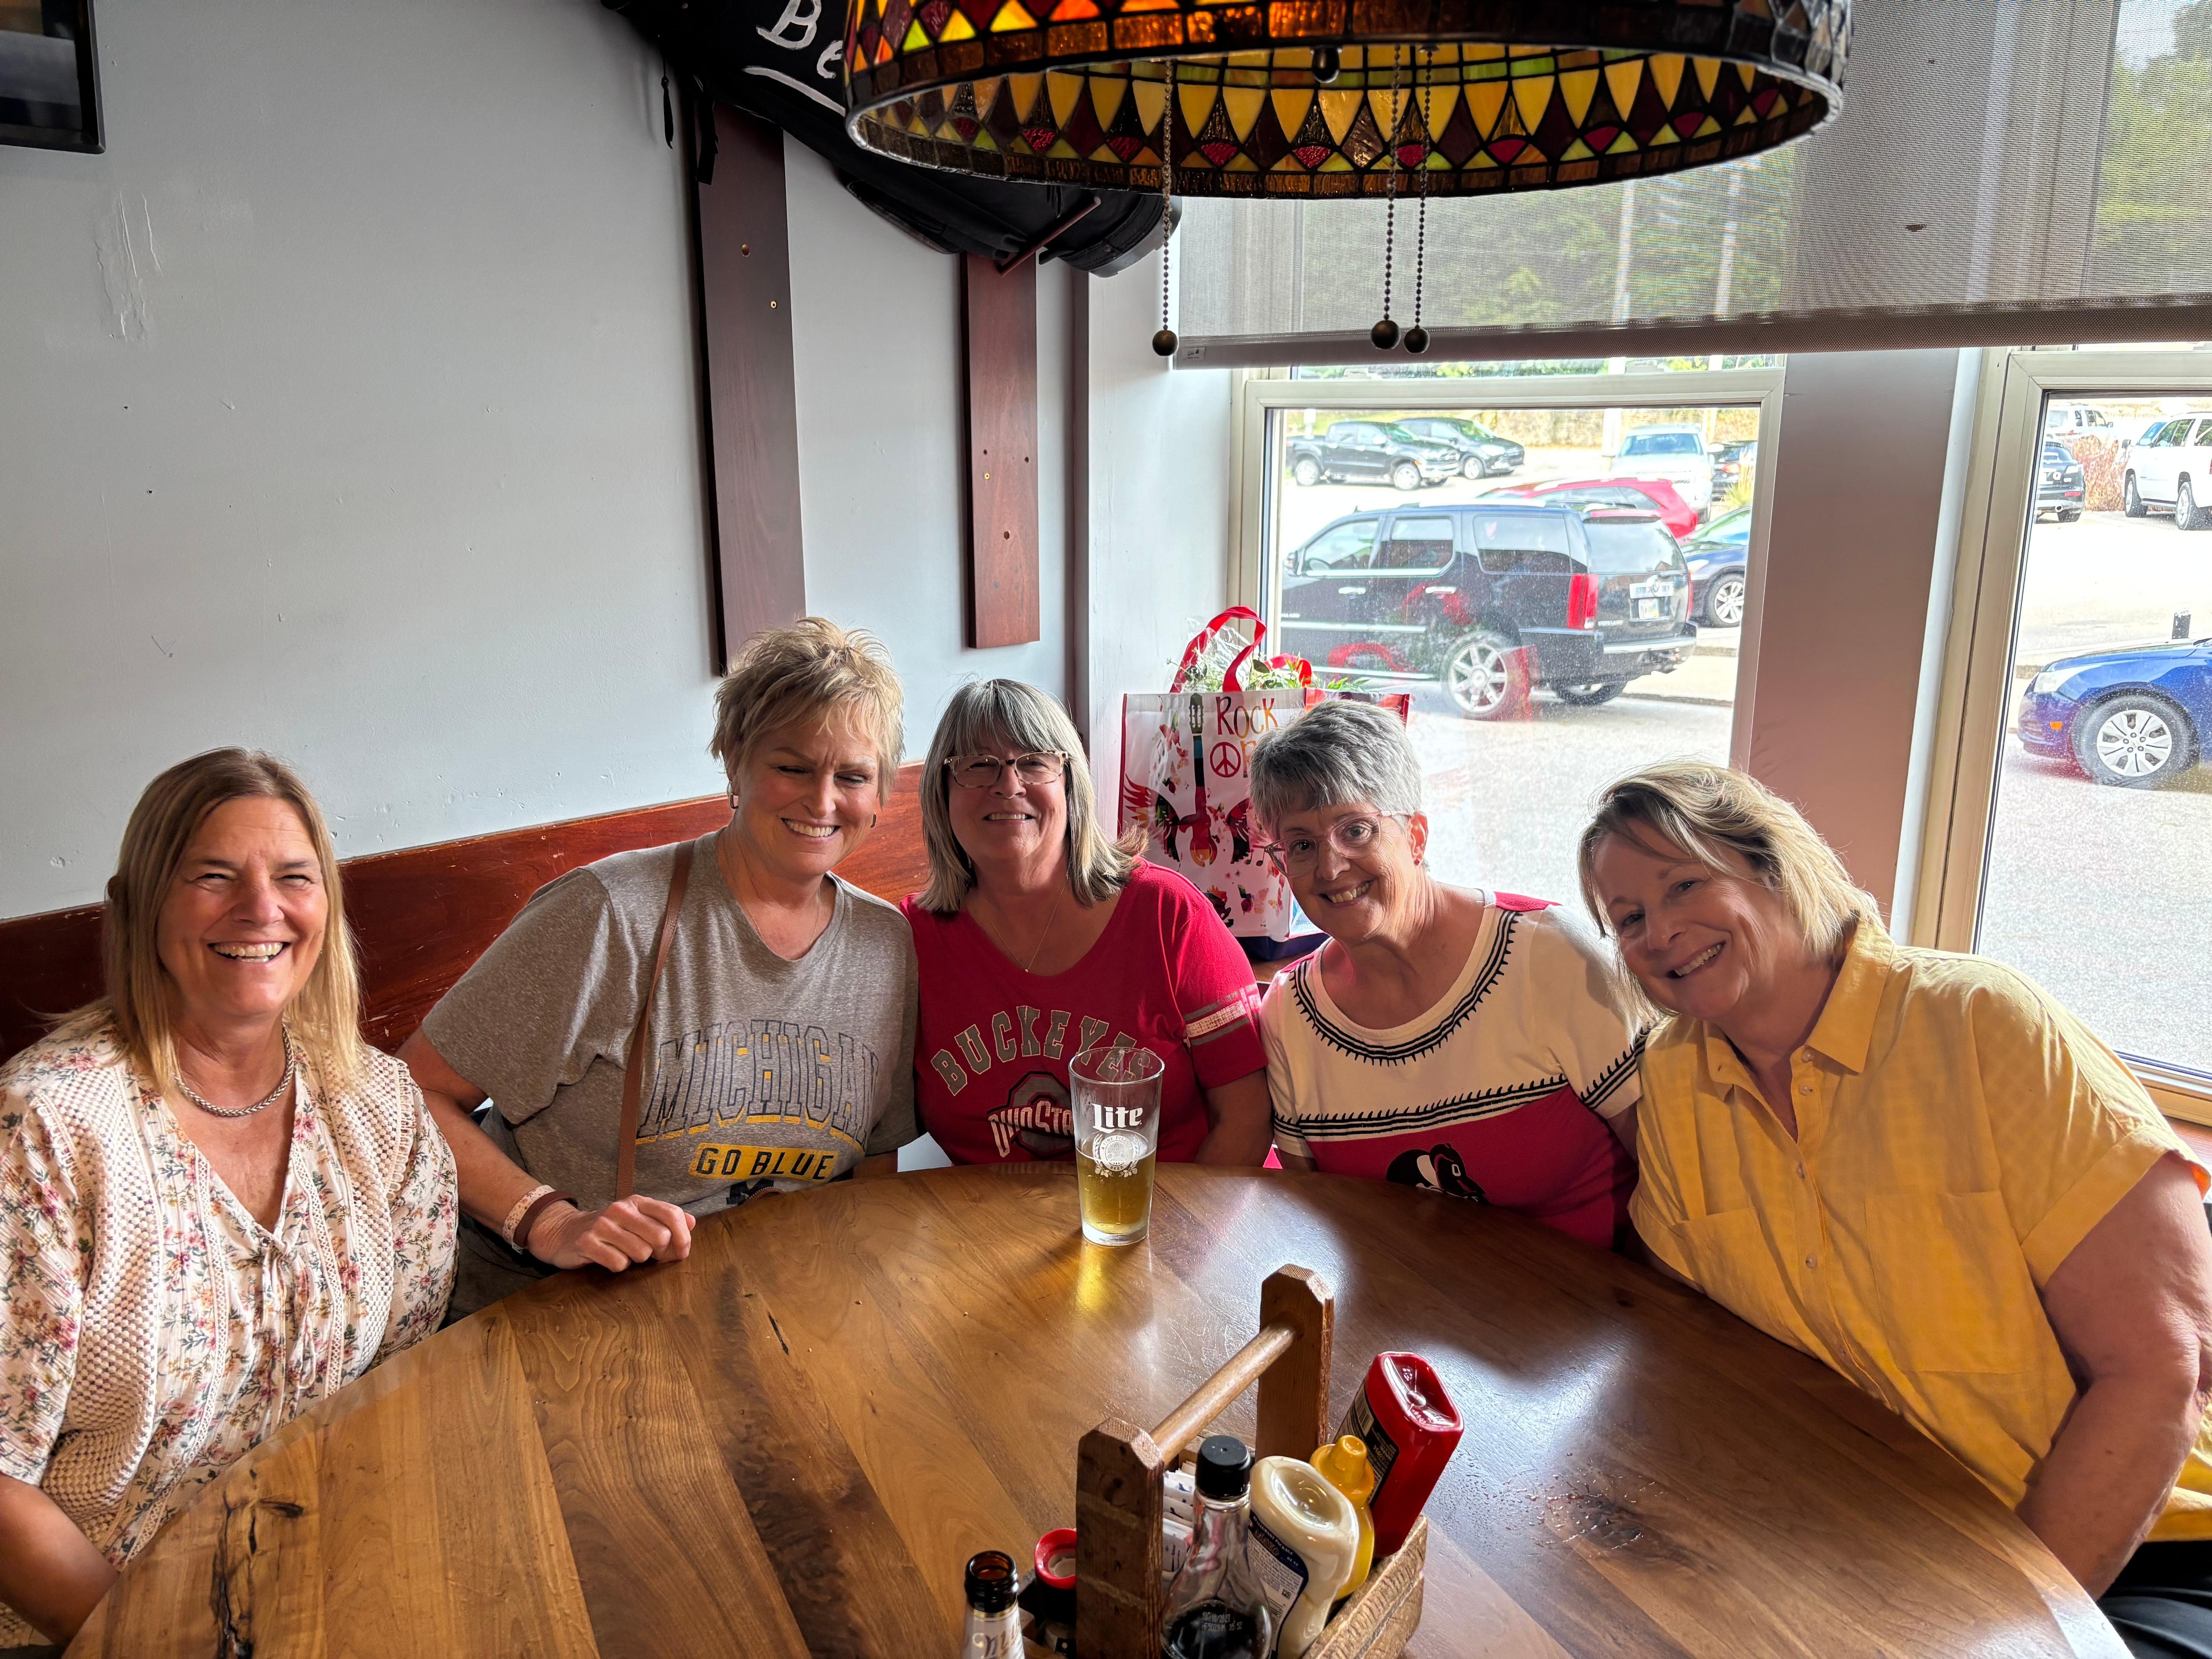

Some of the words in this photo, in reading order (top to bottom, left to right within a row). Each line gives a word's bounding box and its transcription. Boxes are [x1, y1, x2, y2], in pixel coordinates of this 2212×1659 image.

[1215, 696, 1279, 739] ROCK
[636, 1019, 879, 1152] MICHIGAN
[1035, 1100, 1074, 1136] STA
[1091, 1103, 1143, 1133] Lite
[696, 1147, 742, 1175] GO
[749, 1151, 835, 1180] BLUE
